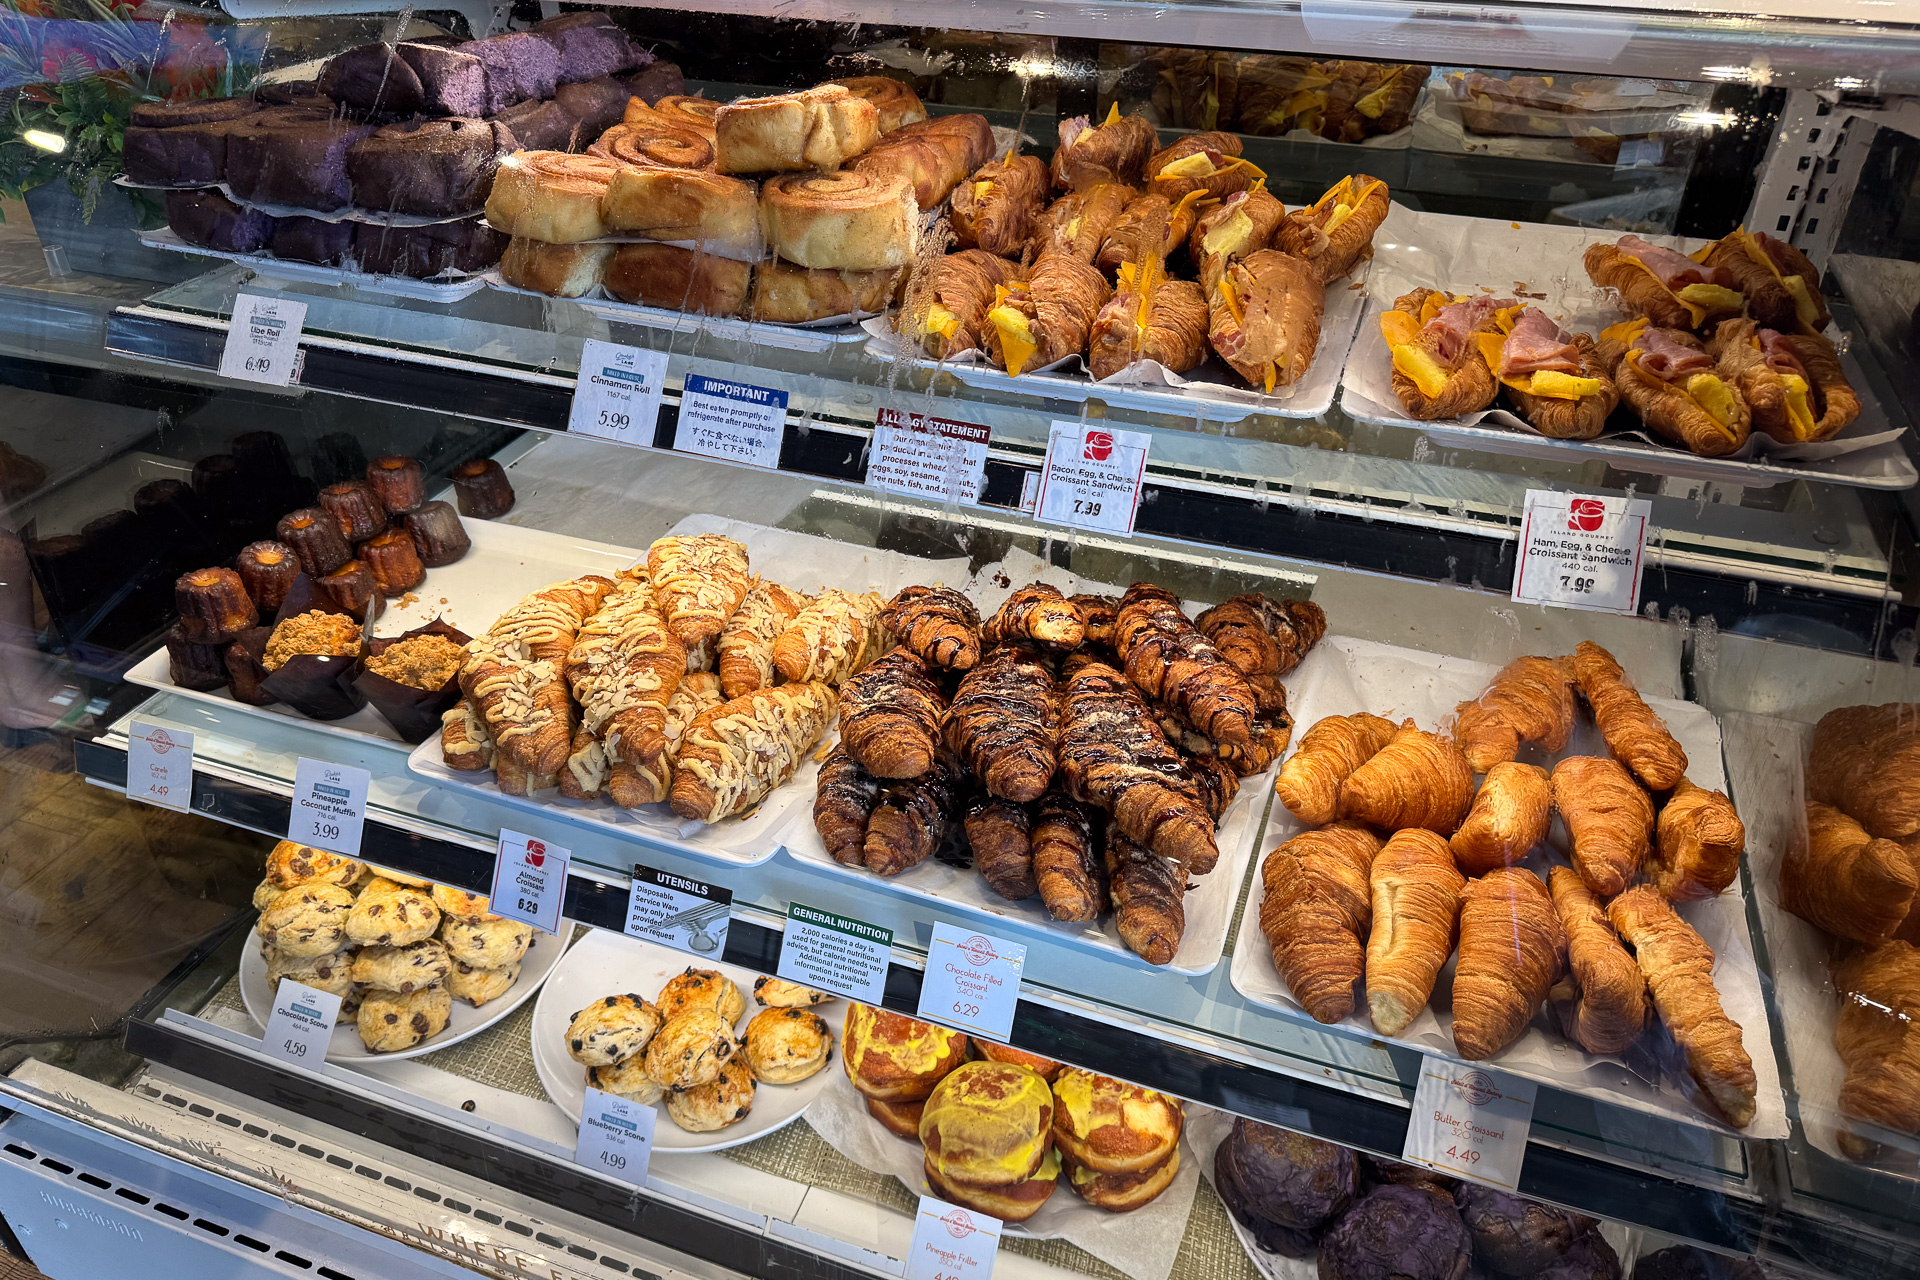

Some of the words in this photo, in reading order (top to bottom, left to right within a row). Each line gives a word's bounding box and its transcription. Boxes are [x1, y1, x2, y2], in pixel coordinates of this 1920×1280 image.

[250, 326, 265, 334] Ube
[266, 329, 280, 337] Roll
[245, 357, 270, 372] 6.49
[634, 385, 650, 394] Roll
[704, 380, 769, 401] IMPORTANT
[693, 401, 709, 410] Best
[710, 405, 729, 414] eaten
[730, 408, 762, 421] promptly
[598, 410, 630, 430] 5.99
[688, 411, 724, 423] refrigerate
[725, 418, 741, 426] after
[742, 421, 775, 433] purchase
[697, 438, 756, 457] 冷やして下さい。
[880, 444, 916, 456] prduced
[882, 455, 920, 467] processes
[894, 468, 908, 476] soy,
[910, 471, 940, 482] sesame,
[1051, 464, 1076, 475] Bacon,
[1079, 469, 1097, 479] Egg,
[887, 475, 906, 486] nuts,
[908, 480, 923, 490] fish,
[925, 483, 940, 492] and
[1051, 474, 1089, 486] Croissant
[1092, 480, 1133, 493] Sandwich
[1074, 500, 1102, 516] 7.99
[1533, 538, 1558, 548] Ham,
[1561, 541, 1582, 552] Egg,
[1580, 533, 1614, 541] GOURMET
[1529, 548, 1578, 560] Croissant
[1581, 553, 1632, 566] Sandwich
[1562, 562, 1580, 570] 440
[1583, 565, 1598, 573] cal.
[1560, 575, 1595, 593] 7.99
[150, 784, 169, 796] 4.49
[312, 792, 347, 805] Pineapple
[301, 799, 331, 811] Coconut
[333, 806, 356, 817] Muffin
[312, 822, 340, 840] 3.99
[514, 861, 529, 869] ISLAND
[516, 877, 545, 892] Croissant
[519, 871, 544, 884] Almond
[657, 872, 709, 895] UTENSILS
[636, 885, 674, 901] Disposable
[518, 898, 538, 914] 6.29
[635, 895, 660, 907] Service
[662, 902, 679, 912] Ware
[632, 914, 663, 926] provided
[634, 905, 649, 914] may
[650, 909, 665, 919] only
[666, 912, 675, 921] be
[631, 923, 648, 933] upon
[649, 928, 675, 940] request
[793, 906, 836, 926] GENERAL
[837, 919, 889, 942] NUTRITION
[802, 927, 821, 938] 2,000
[821, 933, 848, 946] calories
[854, 942, 867, 952] day
[868, 945, 874, 953] is
[786, 940, 810, 952] advice,
[811, 947, 822, 956] but
[823, 951, 846, 962] calorie
[848, 957, 868, 968] needs
[869, 963, 884, 975] vary
[792, 934, 809, 943] used
[809, 938, 819, 946] for
[820, 942, 845, 953] general
[847, 948, 881, 964] nutritional
[798, 952, 832, 967] Additional
[834, 962, 869, 977] nutritional
[794, 960, 832, 976] information
[833, 970, 839, 978] is
[840, 973, 871, 987] available
[809, 973, 825, 983] upon
[826, 978, 853, 990] request
[945, 963, 981, 980] Chocolate
[984, 973, 1003, 986] Filled
[955, 976, 988, 992] Croissant
[956, 986, 973, 997] 340
[953, 1001, 980, 1017] 6.29
[278, 1008, 308, 1023] Chocolate
[310, 1018, 328, 1030] Scone
[284, 1039, 307, 1057] 4.59
[588, 1118, 623, 1135] Blueberry
[624, 1129, 646, 1142] Scone
[1434, 1111, 1460, 1126] Butter
[1464, 1120, 1505, 1140] Croissant
[1451, 1128, 1471, 1140] 320
[606, 1134, 616, 1142] 536
[600, 1151, 626, 1169] 4.99
[1446, 1145, 1481, 1164] 4.49
[418, 1223, 531, 1273] WHERE
[926, 1242, 957, 1260] Pineapple
[958, 1253, 978, 1267] Fritter
[939, 1256, 953, 1267] 350
